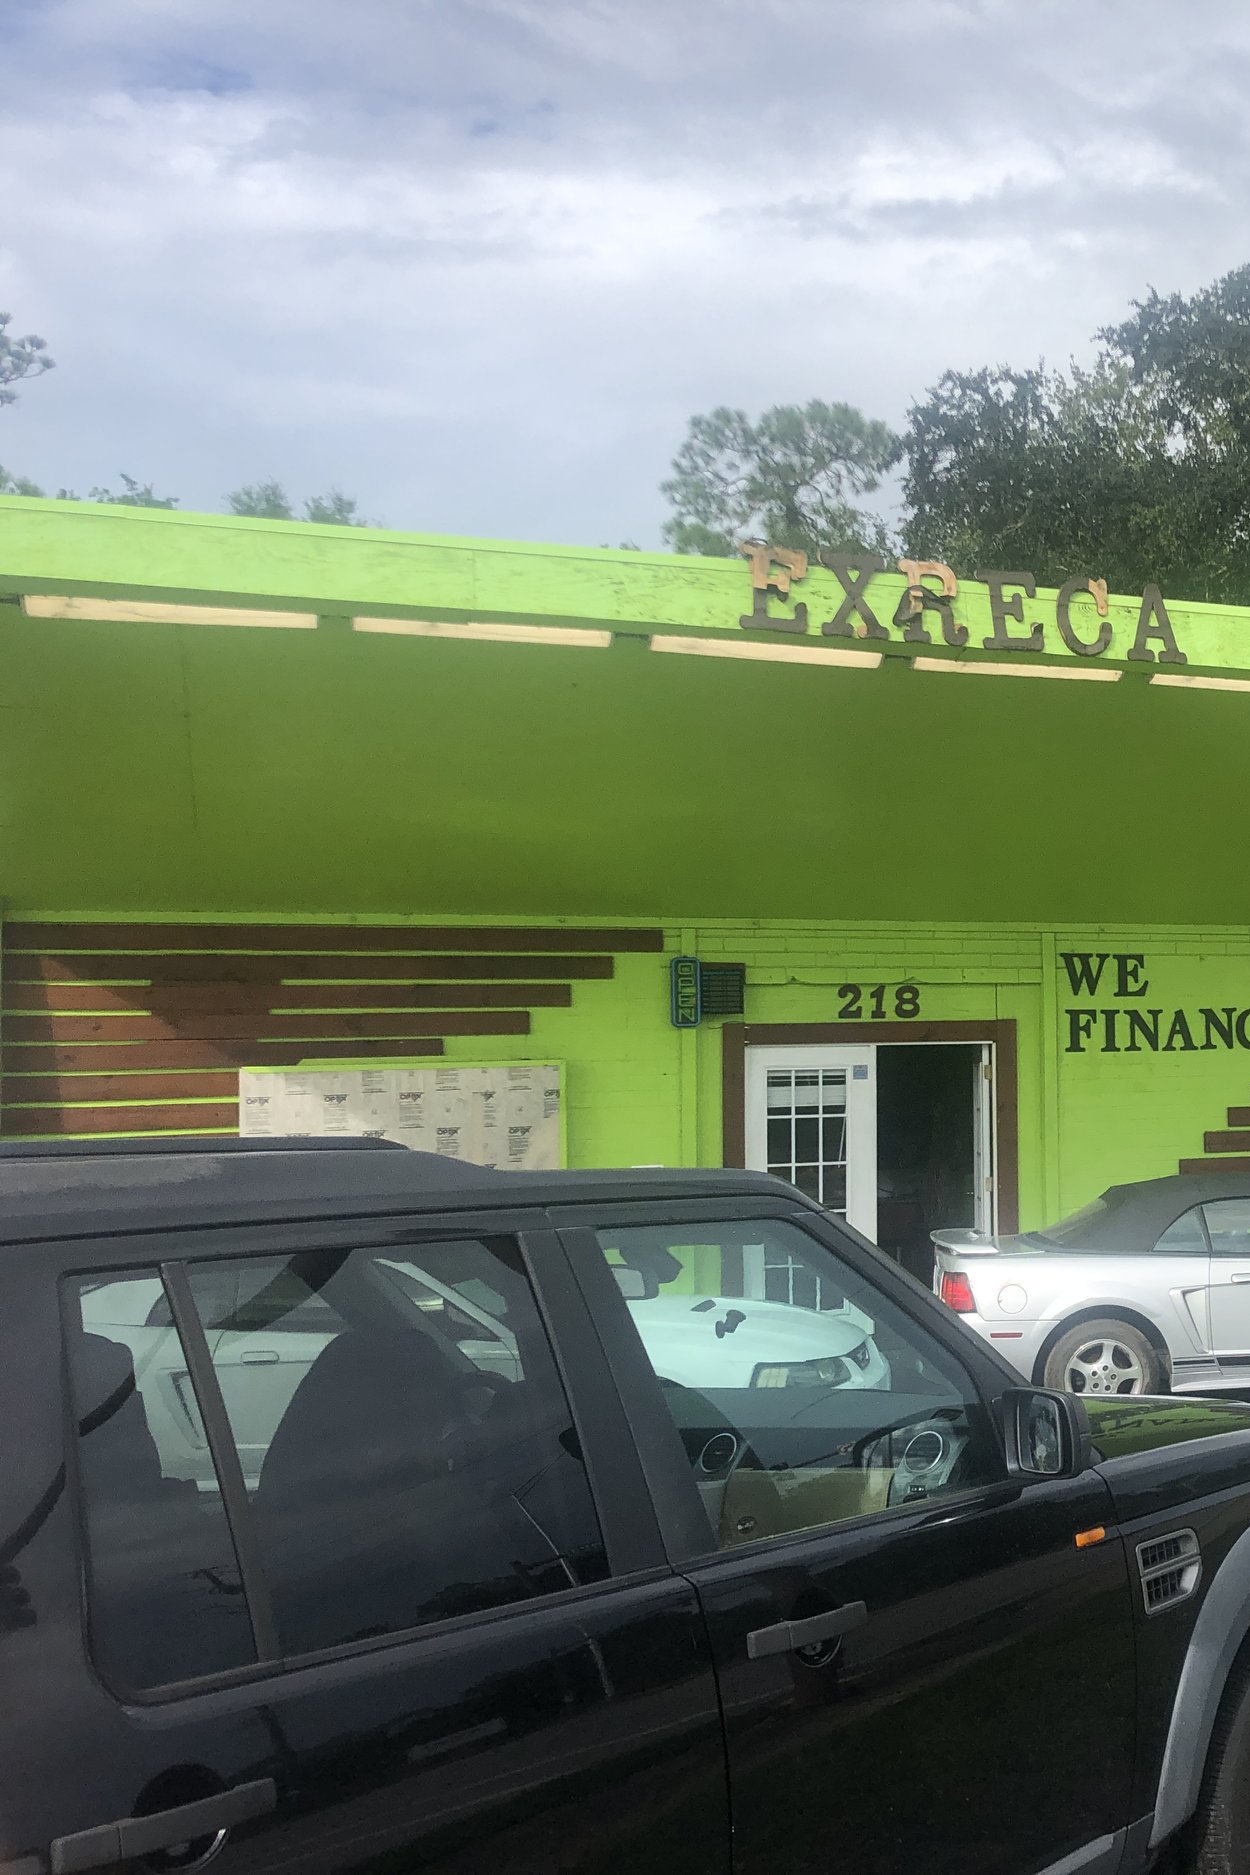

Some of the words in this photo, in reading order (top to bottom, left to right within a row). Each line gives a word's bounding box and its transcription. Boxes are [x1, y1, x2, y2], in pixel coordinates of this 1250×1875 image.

[739, 538, 1188, 665] EXRECA
[678, 962, 696, 1022] OPEN
[1060, 953, 1149, 997] WE
[838, 984, 920, 1019] 218
